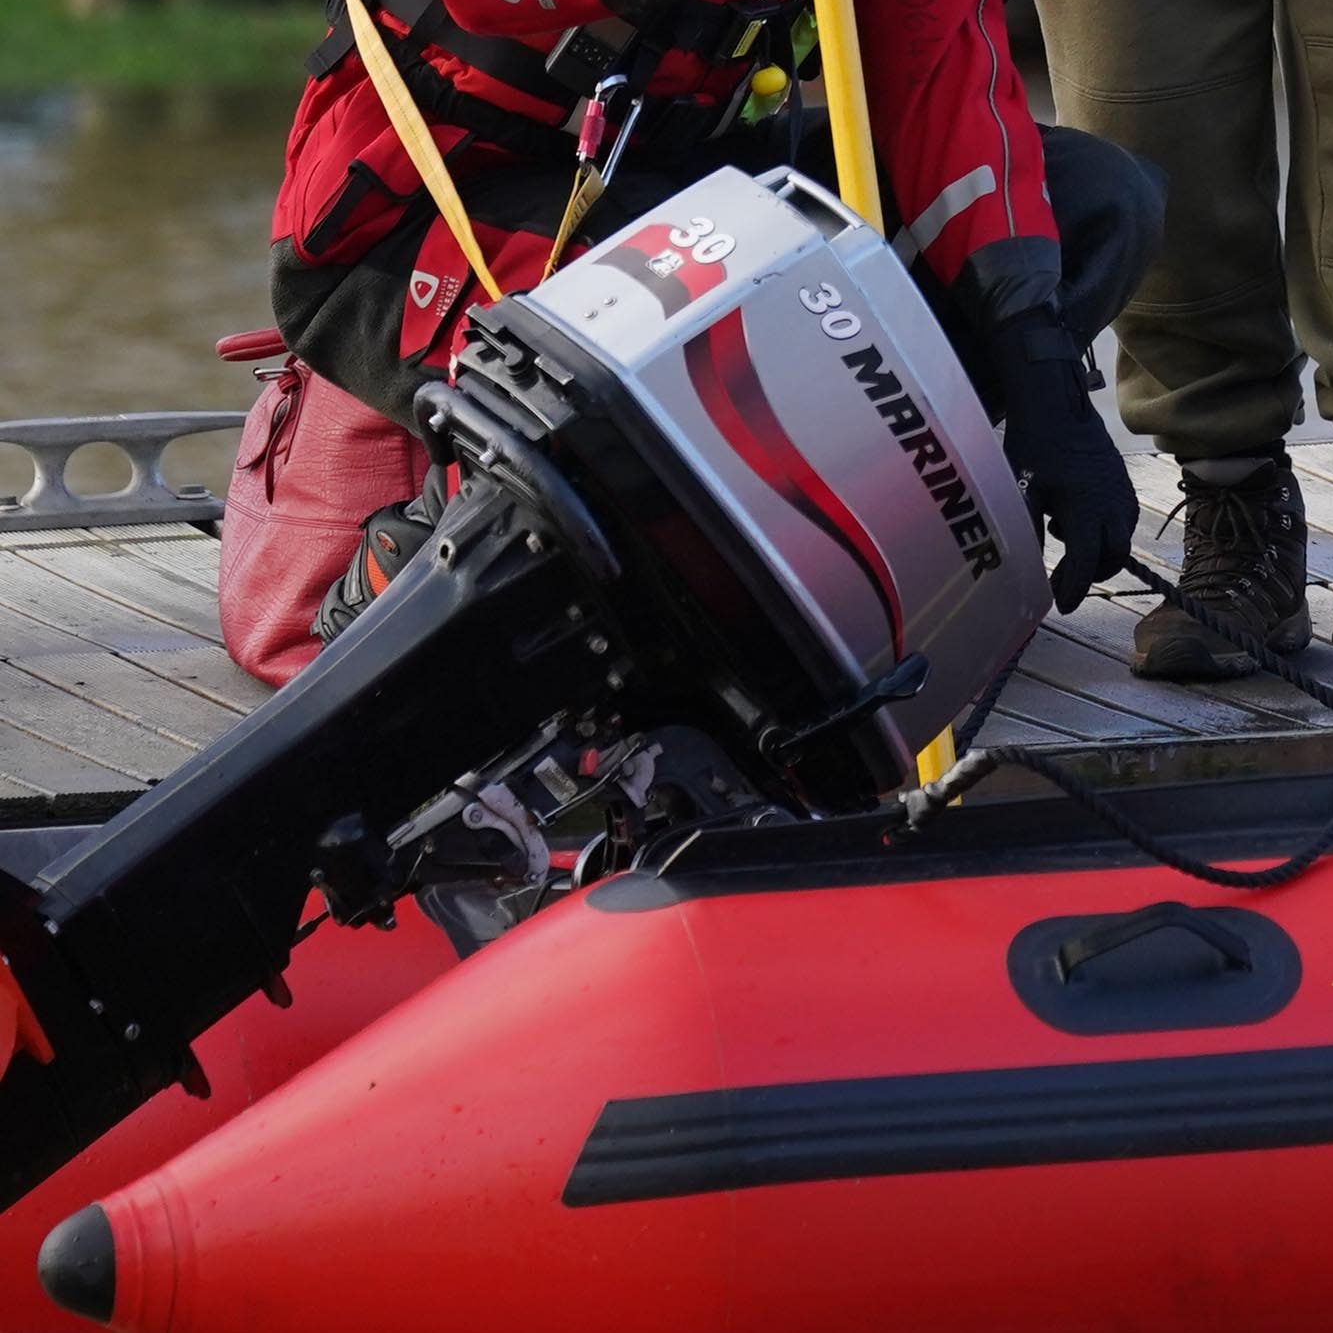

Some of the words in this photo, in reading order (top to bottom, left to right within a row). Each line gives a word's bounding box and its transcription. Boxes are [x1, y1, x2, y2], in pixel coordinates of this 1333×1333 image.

[669, 217, 737, 264] 30
[797, 281, 862, 341] 30
[841, 343, 1003, 581] MARINER
